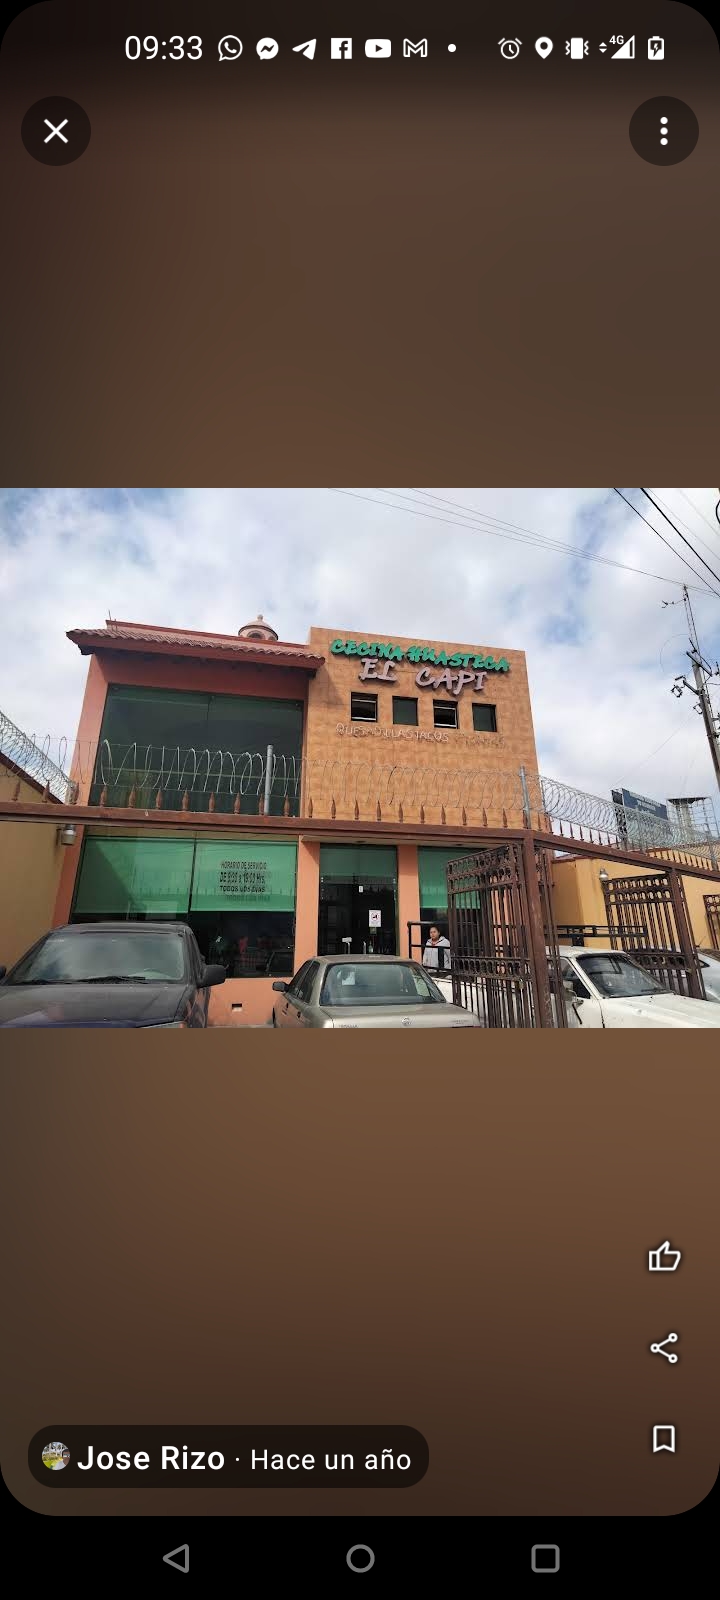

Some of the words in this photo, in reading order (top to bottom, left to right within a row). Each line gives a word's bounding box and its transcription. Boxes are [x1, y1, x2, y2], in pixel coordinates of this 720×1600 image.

[331, 638, 404, 662] CECINA
[406, 645, 510, 673] HUASTECA
[359, 657, 398, 682] EL
[415, 666, 487, 695] CAPI
[219, 871, 227, 883] DE
[221, 861, 240, 870] HORARIO
